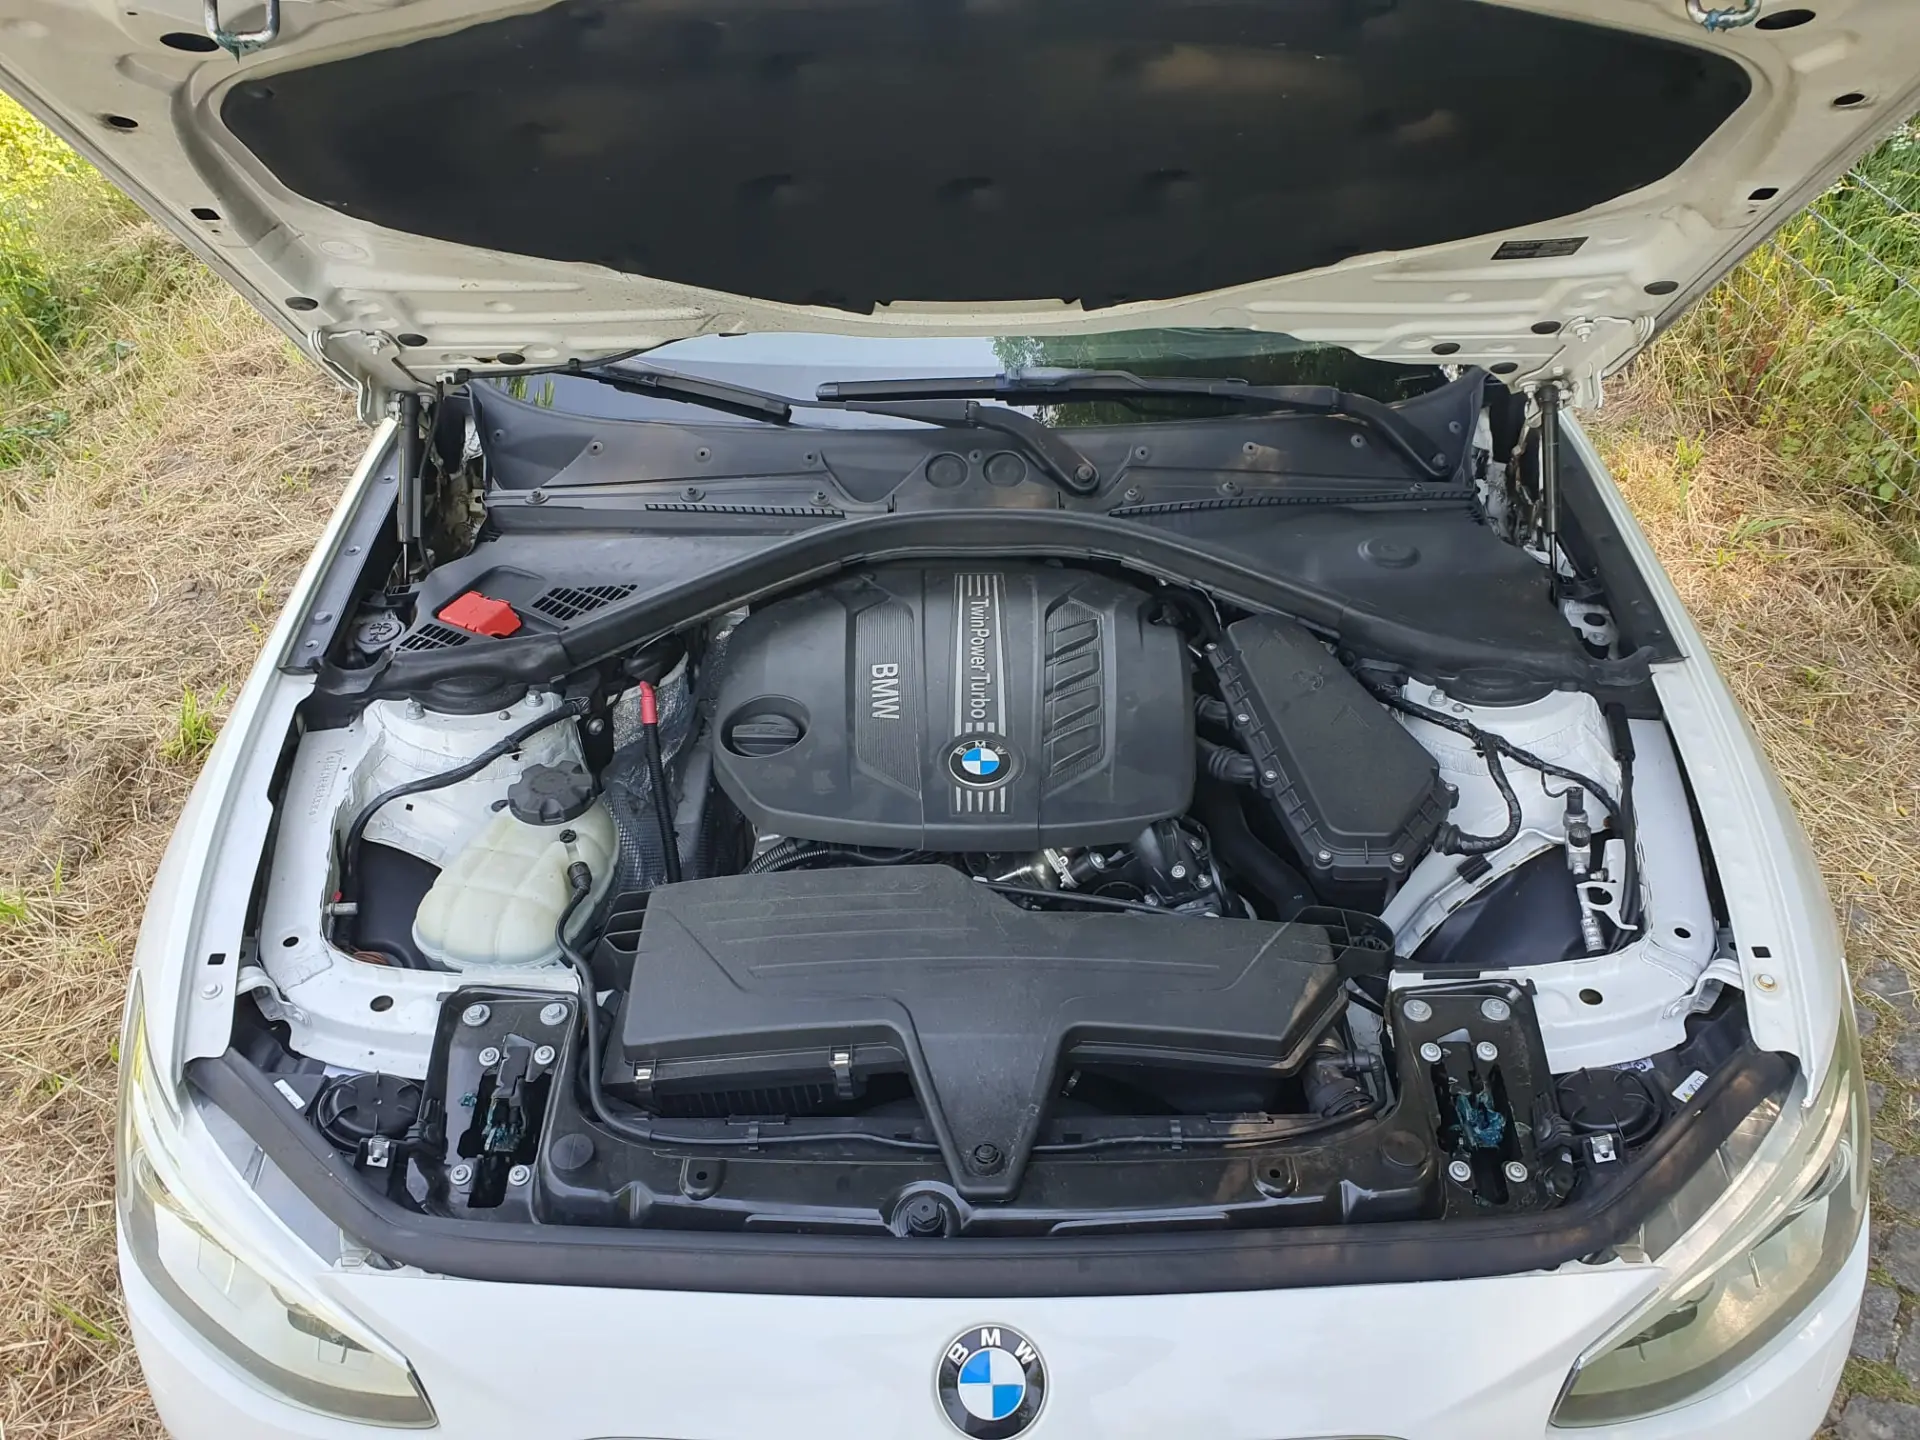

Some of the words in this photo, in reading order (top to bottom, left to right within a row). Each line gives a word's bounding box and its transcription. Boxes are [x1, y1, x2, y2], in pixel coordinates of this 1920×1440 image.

[970, 598, 990, 671] TwinPower
[871, 663, 900, 720] BMW
[970, 673, 991, 719] Turbo
[953, 740, 1008, 755] BMW
[947, 1328, 1037, 1366] BMW
